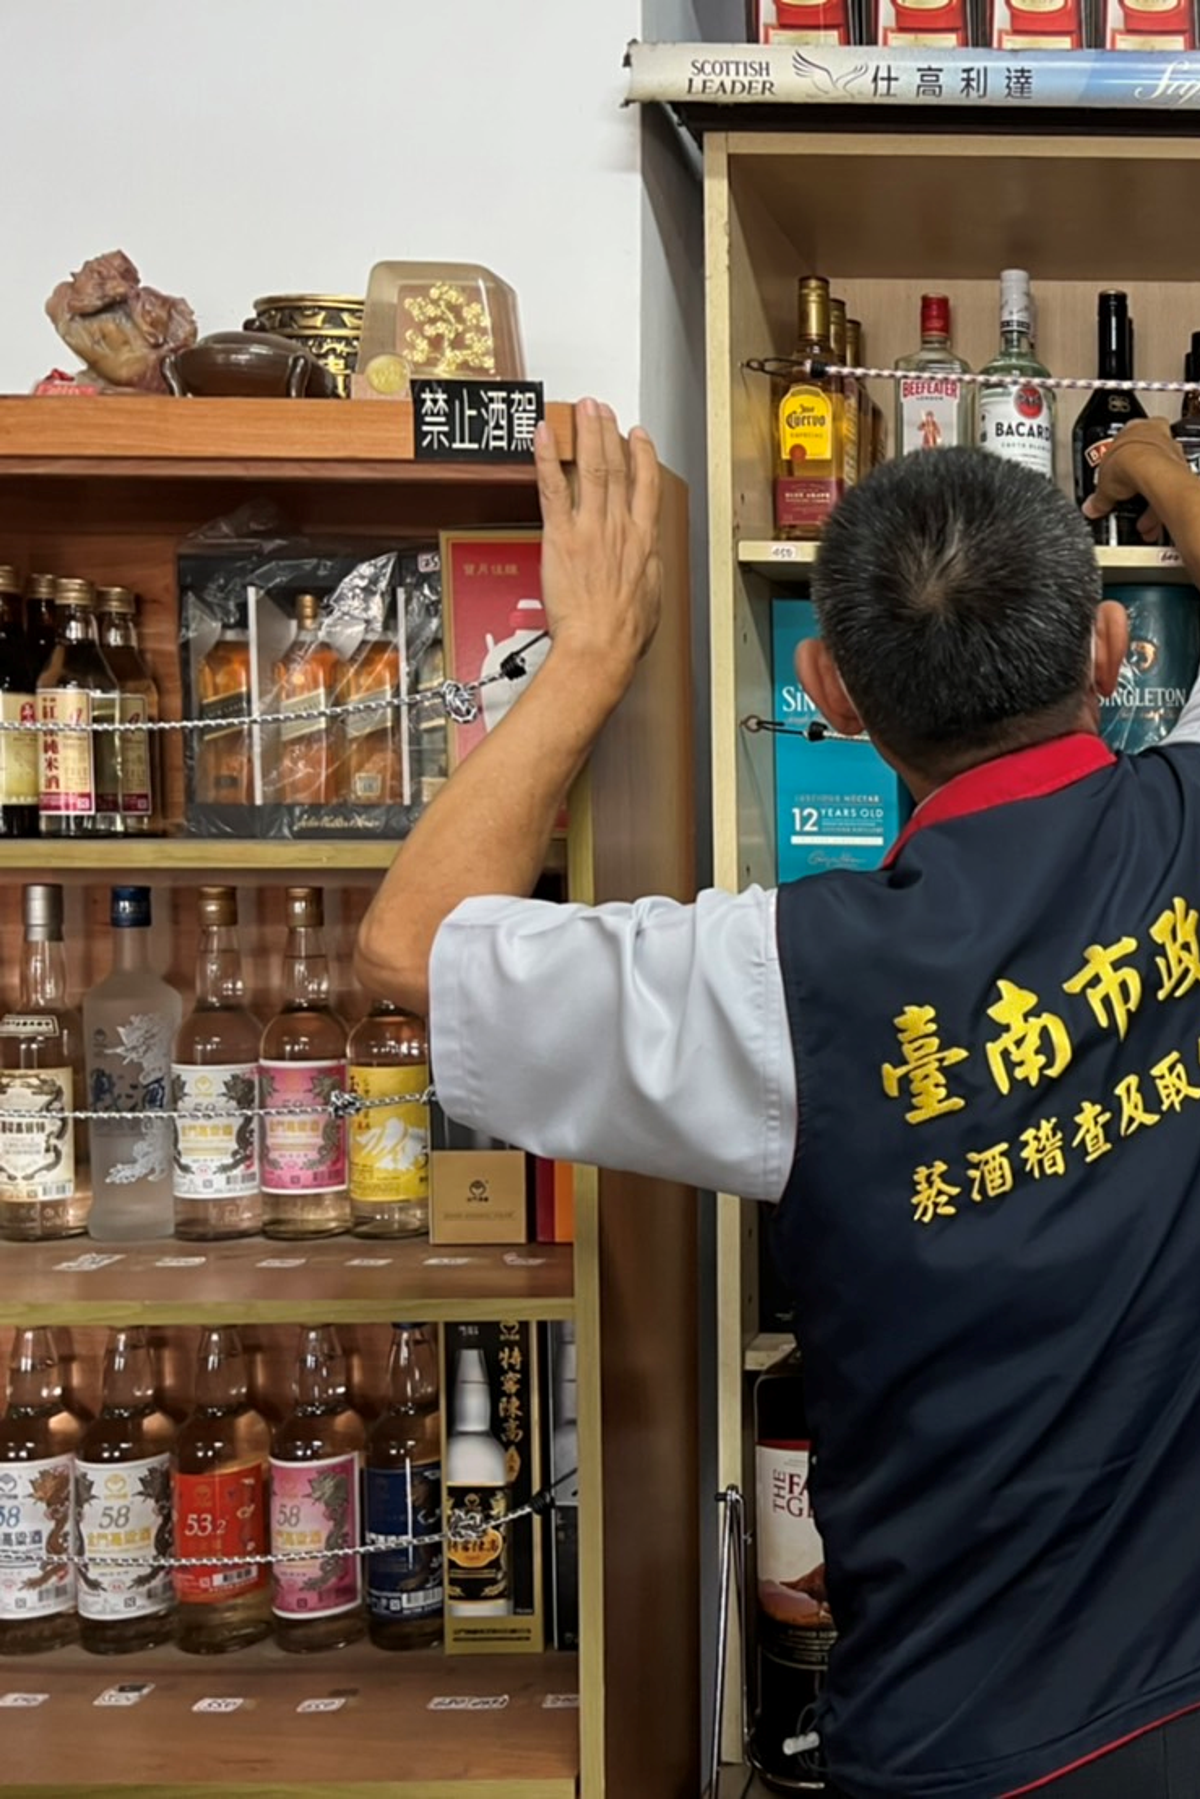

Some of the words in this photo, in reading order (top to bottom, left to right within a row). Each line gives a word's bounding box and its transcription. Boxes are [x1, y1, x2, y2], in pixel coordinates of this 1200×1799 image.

[690, 58, 771, 77] SCOTTISH
[687, 78, 776, 98] LEADER
[871, 65, 1035, 100] 仕高利達
[902, 379, 960, 400] BEEFEATER
[420, 386, 537, 453] 禁止酒駕
[785, 411, 827, 430] Cuervo
[791, 807, 819, 832] 12
[820, 807, 857, 819] YEARS
[859, 807, 884, 819] OLD
[99, 1505, 132, 1529] 58
[277, 1504, 302, 1529] 58
[275, 1530, 323, 1547] 門高粱酒
